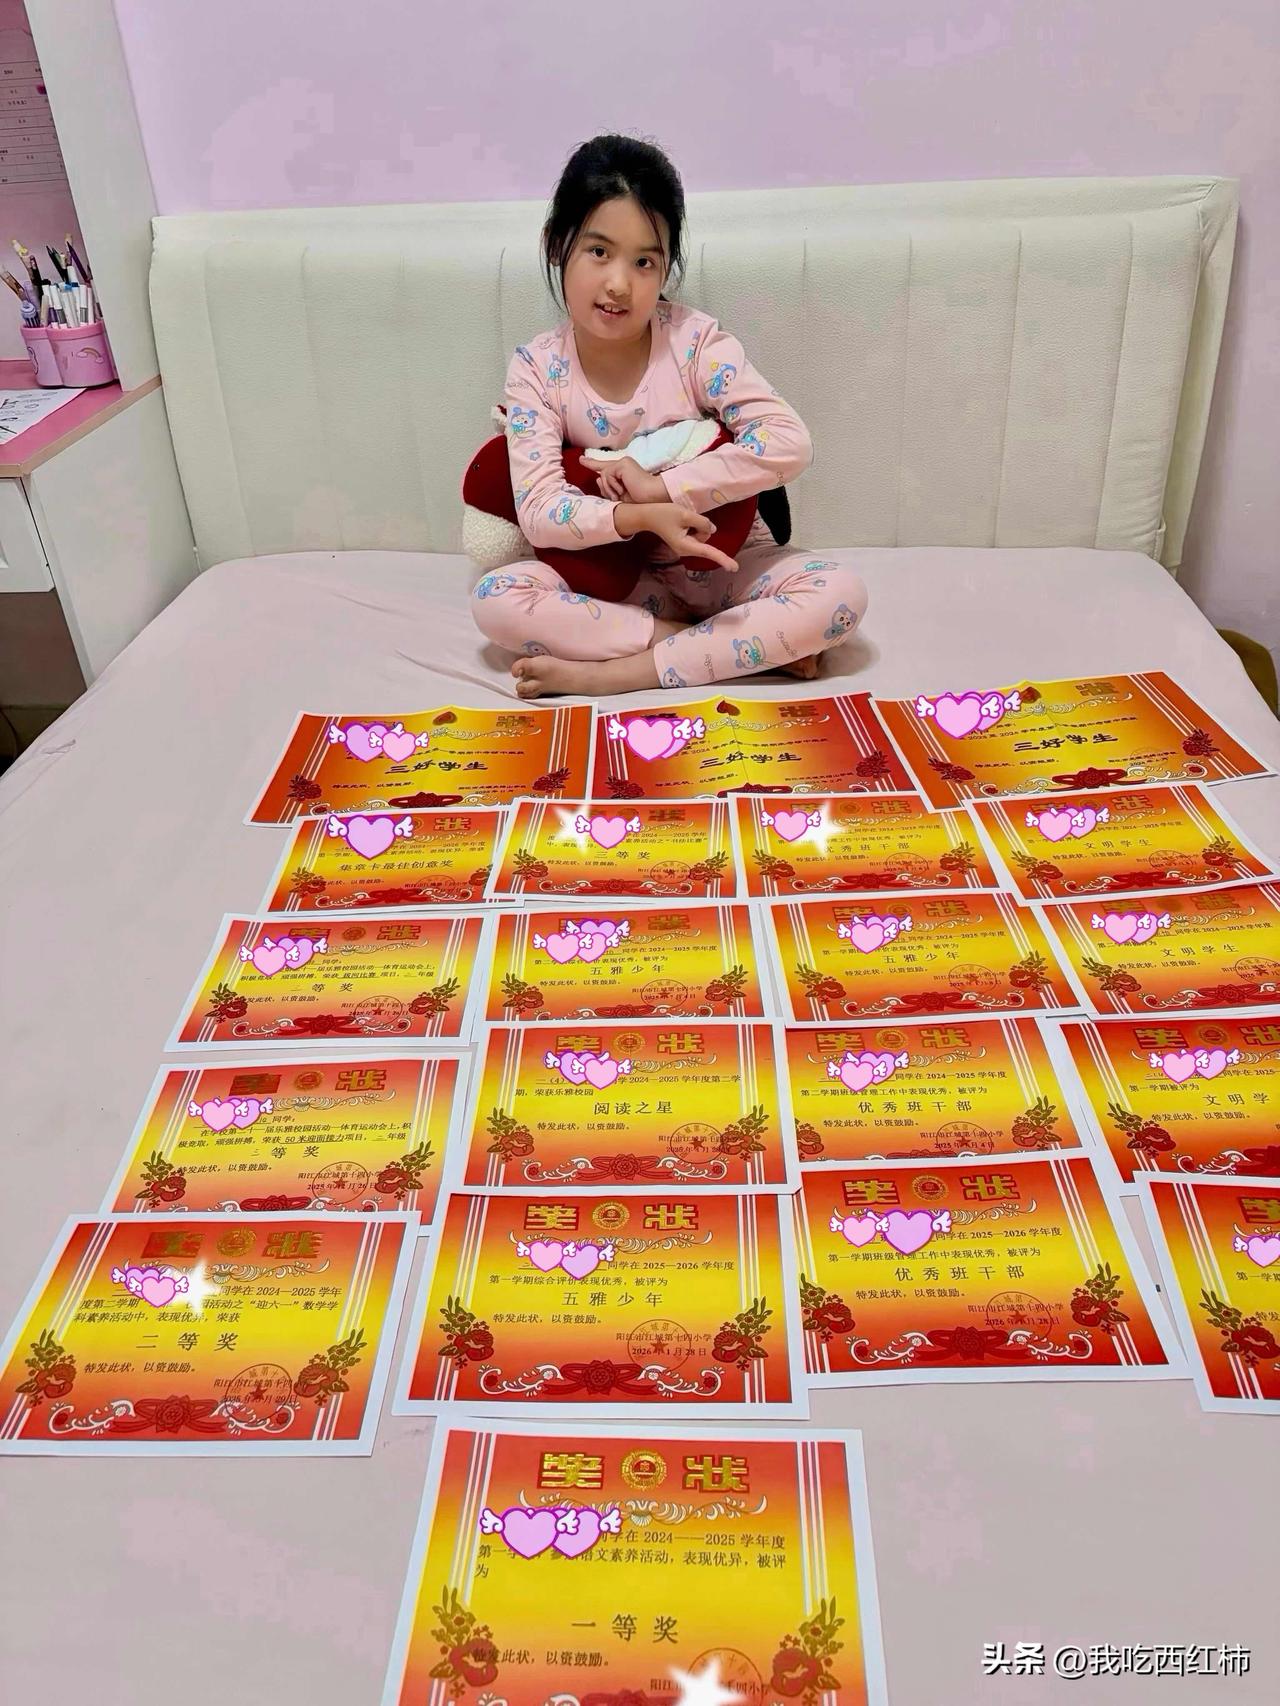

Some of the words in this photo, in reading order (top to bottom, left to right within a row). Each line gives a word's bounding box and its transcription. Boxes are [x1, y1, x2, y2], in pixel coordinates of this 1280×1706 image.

[1014, 733, 1118, 752] 三好学生
[385, 760, 488, 774] 三好学生
[700, 751, 802, 769] 三好学生
[1084, 838, 1152, 850] 文明学生
[595, 851, 651, 859] 三等奖
[340, 860, 454, 872] 集章卡最佳创意奖
[884, 951, 960, 964] 五雅少年
[1161, 944, 1239, 958] 文明学生
[590, 964, 664, 976] 五雅少年
[656, 1032, 705, 1055] 状
[815, 1032, 866, 1052] 奖
[920, 1027, 972, 1049] 状
[1133, 1027, 1190, 1049] 奖
[335, 1069, 387, 1092] 状
[1203, 1092, 1270, 1106] 文明学
[594, 1101, 673, 1115] 阅读之星
[858, 1101, 973, 1114] 优秀班干部
[823, 1119, 919, 1128] 特发此状，以资鼓励。
[843, 1178, 901, 1206] 奖
[960, 1174, 1021, 1202] 状
[523, 1204, 580, 1231] 奖
[642, 1203, 699, 1231] 状
[935, 1228, 1063, 1241] 同学在2025—2026学年度
[262, 1230, 324, 1259] 状
[828, 1247, 1041, 1262] 第一学期班级管理工作中表现优秀，被评为
[607, 1261, 735, 1271] 同学在2025—2026学年度
[895, 1265, 1026, 1281] 优秀班干部
[489, 1274, 668, 1287] 第一学期综合评价表现优秀，被评为
[561, 1291, 663, 1307] 五雅少年
[856, 1288, 966, 1300] 特发此状，以资鼓励。
[493, 1314, 602, 1324] 特发此状，以资鼓励。
[136, 1332, 238, 1351] 二等奖
[616, 1332, 713, 1342] 阳江市江城第十四小学
[84, 1362, 196, 1373] 特发此状，以资鼓励。
[537, 1452, 605, 1490] 奖
[683, 1453, 750, 1494] 状
[475, 1563, 489, 1578] 为
[571, 1614, 679, 1644] 一等奖
